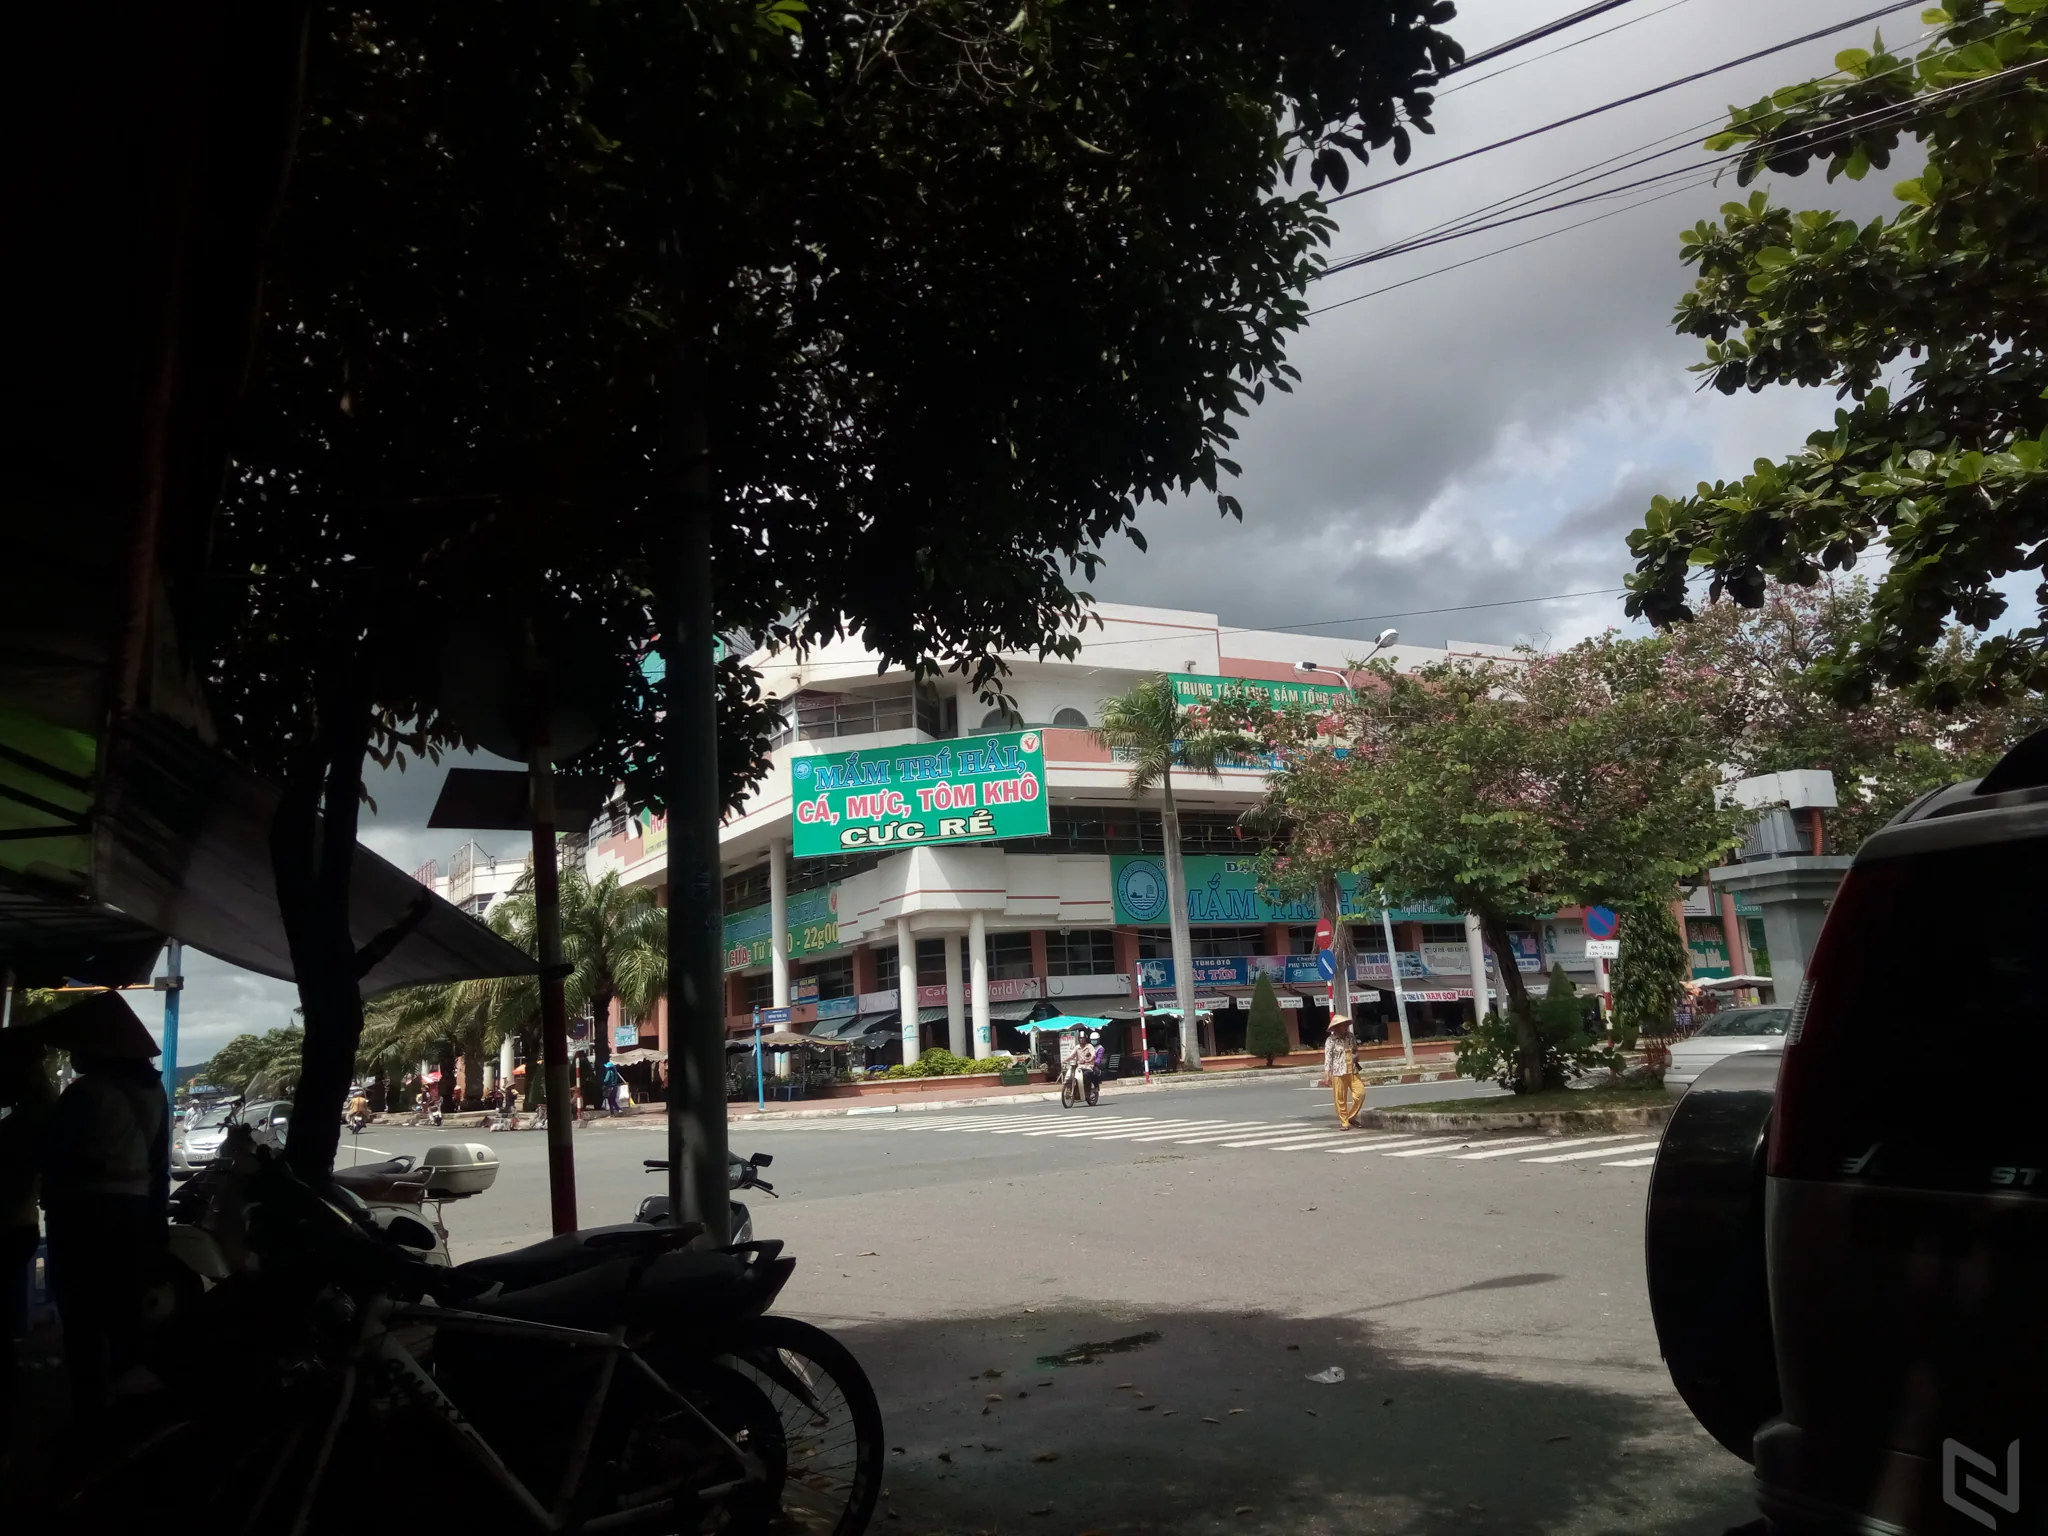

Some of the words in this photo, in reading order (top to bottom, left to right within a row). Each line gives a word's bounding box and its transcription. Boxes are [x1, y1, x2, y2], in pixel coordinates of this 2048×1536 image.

[1176, 681, 1213, 696] TRUNG
[1274, 684, 1298, 702] SẮM
[815, 752, 890, 791] MẮM
[896, 746, 951, 782] TRÍ
[957, 739, 1027, 775] HẢI,
[797, 795, 840, 825] CÁ,
[846, 789, 912, 822] MỰC,
[917, 782, 976, 812] TÔM
[984, 772, 1040, 805] KHÔ
[840, 820, 926, 847] CỰC
[938, 809, 996, 836] RẺ
[925, 987, 948, 998] Caf
[988, 982, 1013, 996] orld
